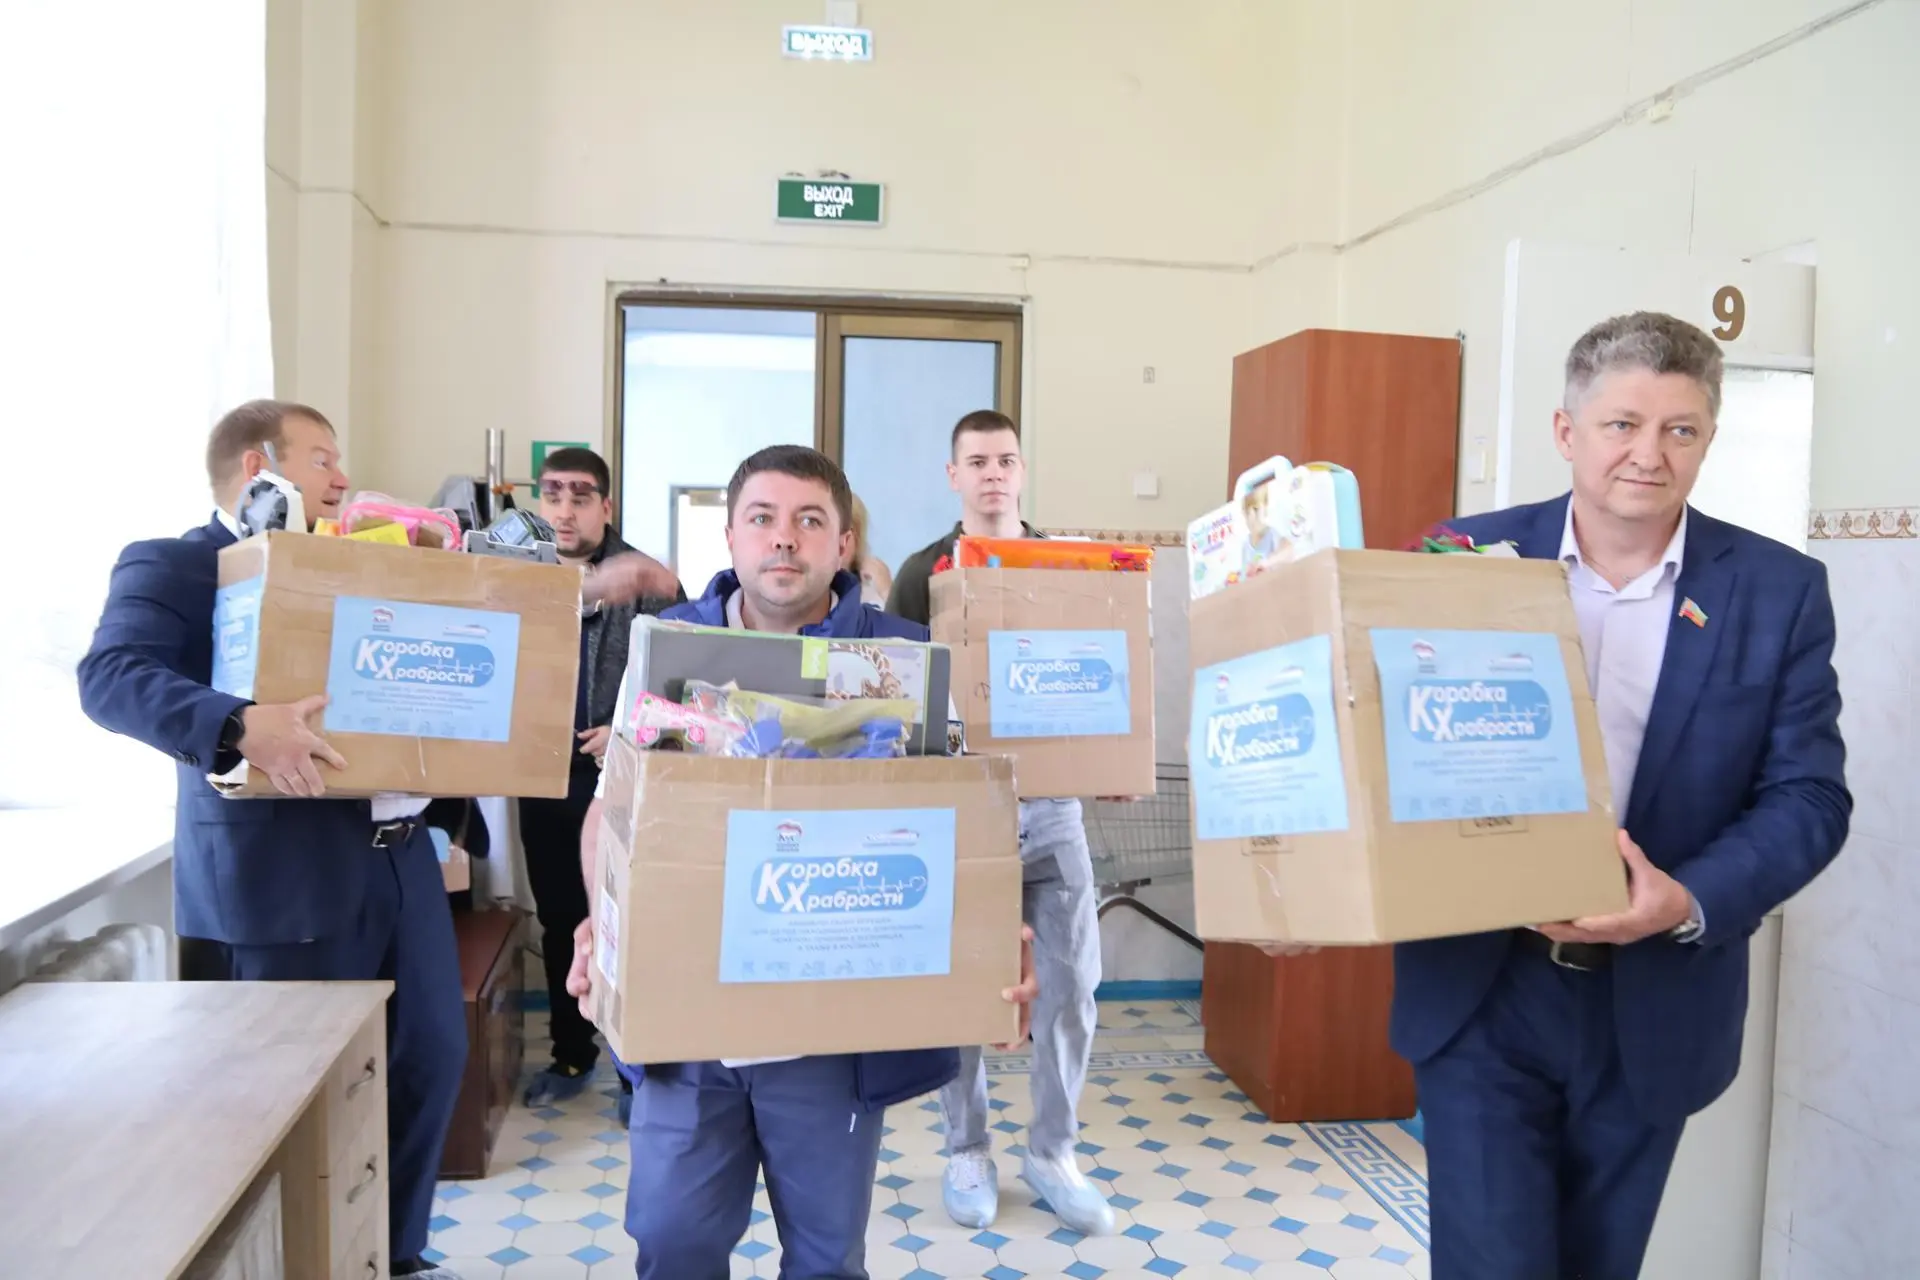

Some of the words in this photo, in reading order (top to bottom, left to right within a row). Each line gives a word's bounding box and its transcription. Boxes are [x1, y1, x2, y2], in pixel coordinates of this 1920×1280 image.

[790, 32, 864, 55] ВЫХОД
[803, 185, 853, 206] ВЫХОД
[814, 203, 845, 218] EXIT
[1712, 285, 1745, 341] 9
[355, 638, 455, 671] Коробка
[373, 655, 475, 684] Храбрости
[1409, 681, 1507, 732] Коробка
[1433, 706, 1536, 742] Храбрости
[756, 857, 879, 905] Коробка
[780, 880, 904, 913] Храбрости
